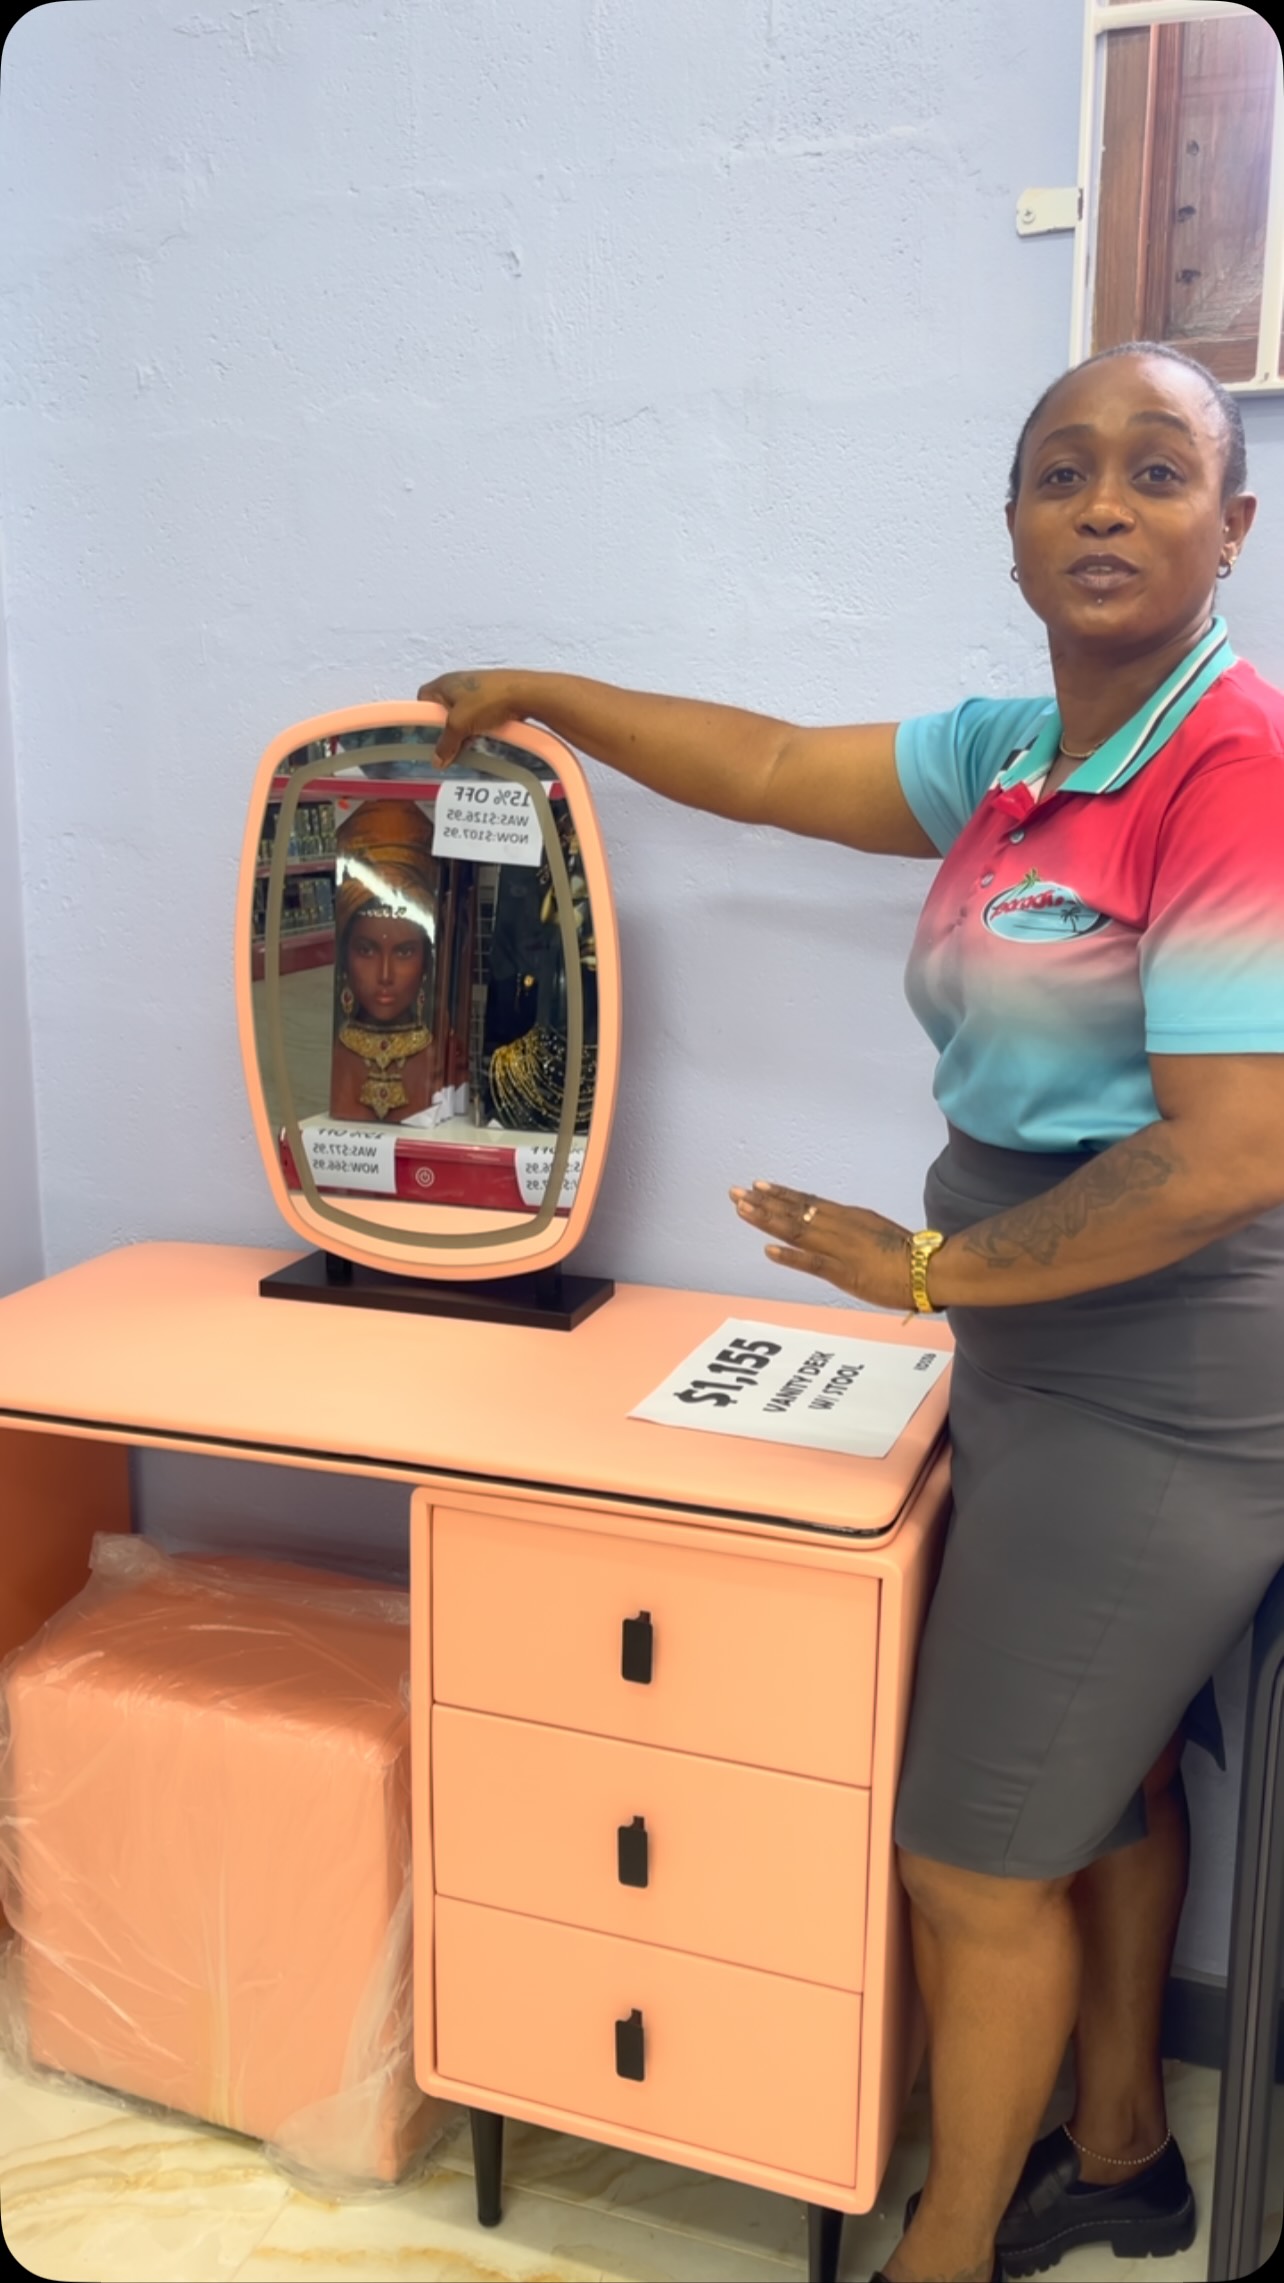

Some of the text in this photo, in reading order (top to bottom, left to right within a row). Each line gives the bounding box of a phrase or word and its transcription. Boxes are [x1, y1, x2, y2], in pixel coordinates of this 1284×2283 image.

[673, 1337, 783, 1408] $1,155
[763, 1350, 835, 1413] VANITY DESK
[808, 1363, 865, 1410] W/ STOOL
